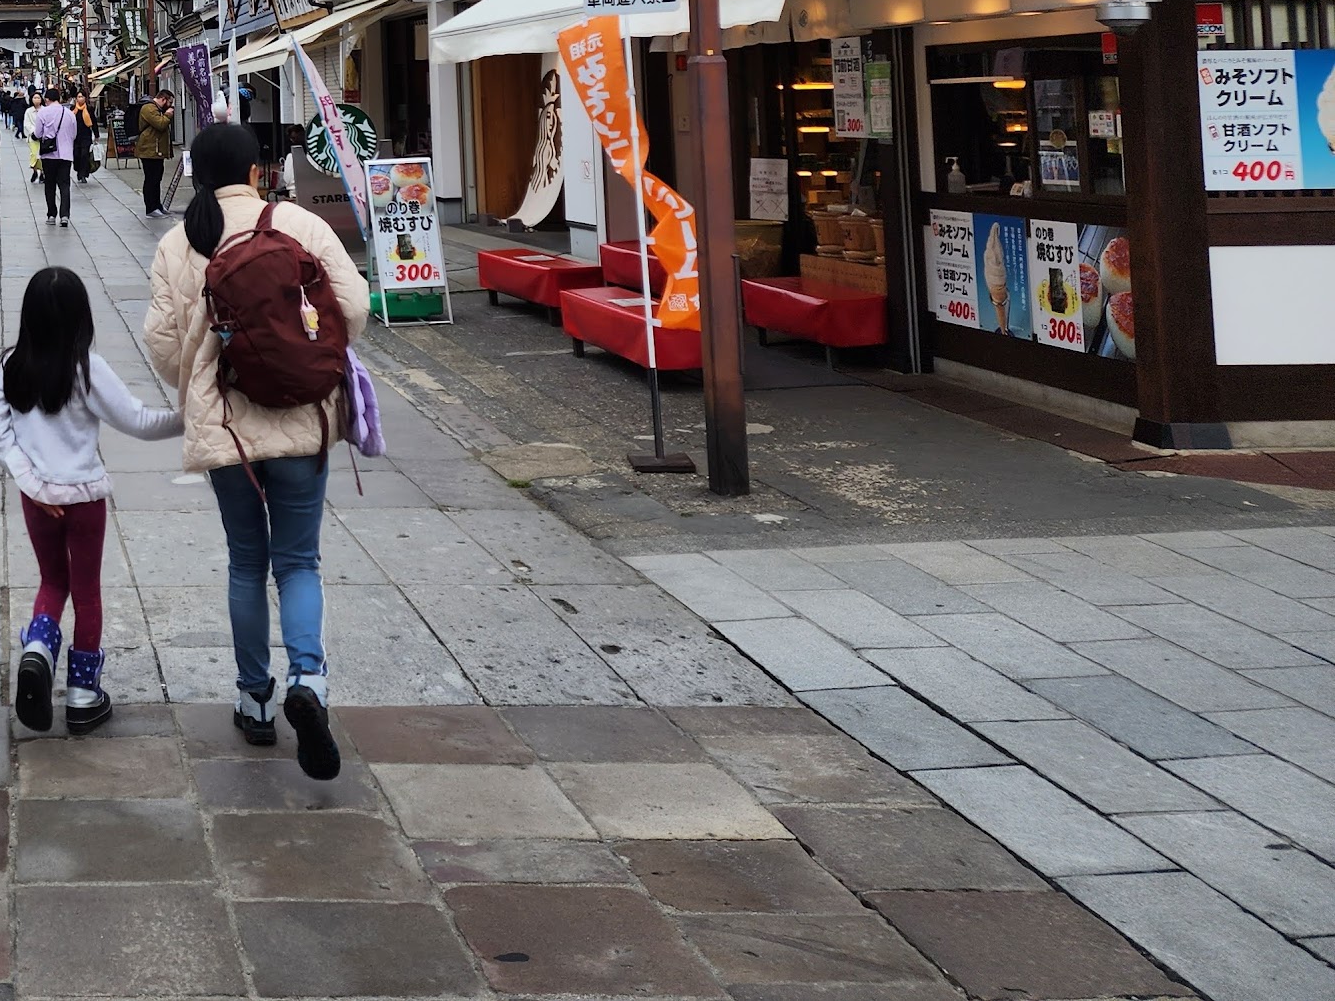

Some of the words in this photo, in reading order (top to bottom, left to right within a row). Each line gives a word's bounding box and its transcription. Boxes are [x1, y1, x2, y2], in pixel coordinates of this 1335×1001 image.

[1215, 68, 1294, 85] みそソフト
[1216, 90, 1284, 107] クリーム
[1222, 123, 1292, 137] 甘酒ソフト
[1223, 139, 1279, 152] クリーム
[312, 193, 350, 205] STARB
[386, 201, 420, 215] のり巻
[378, 214, 433, 233] 焼むすび
[938, 222, 974, 241] みそソフト
[1035, 227, 1054, 241] のり巻
[939, 241, 970, 259] クリーム
[1036, 242, 1075, 265] 焼むすび
[942, 268, 974, 284] 甘酒ソフト
[943, 282, 969, 297] クリーム
